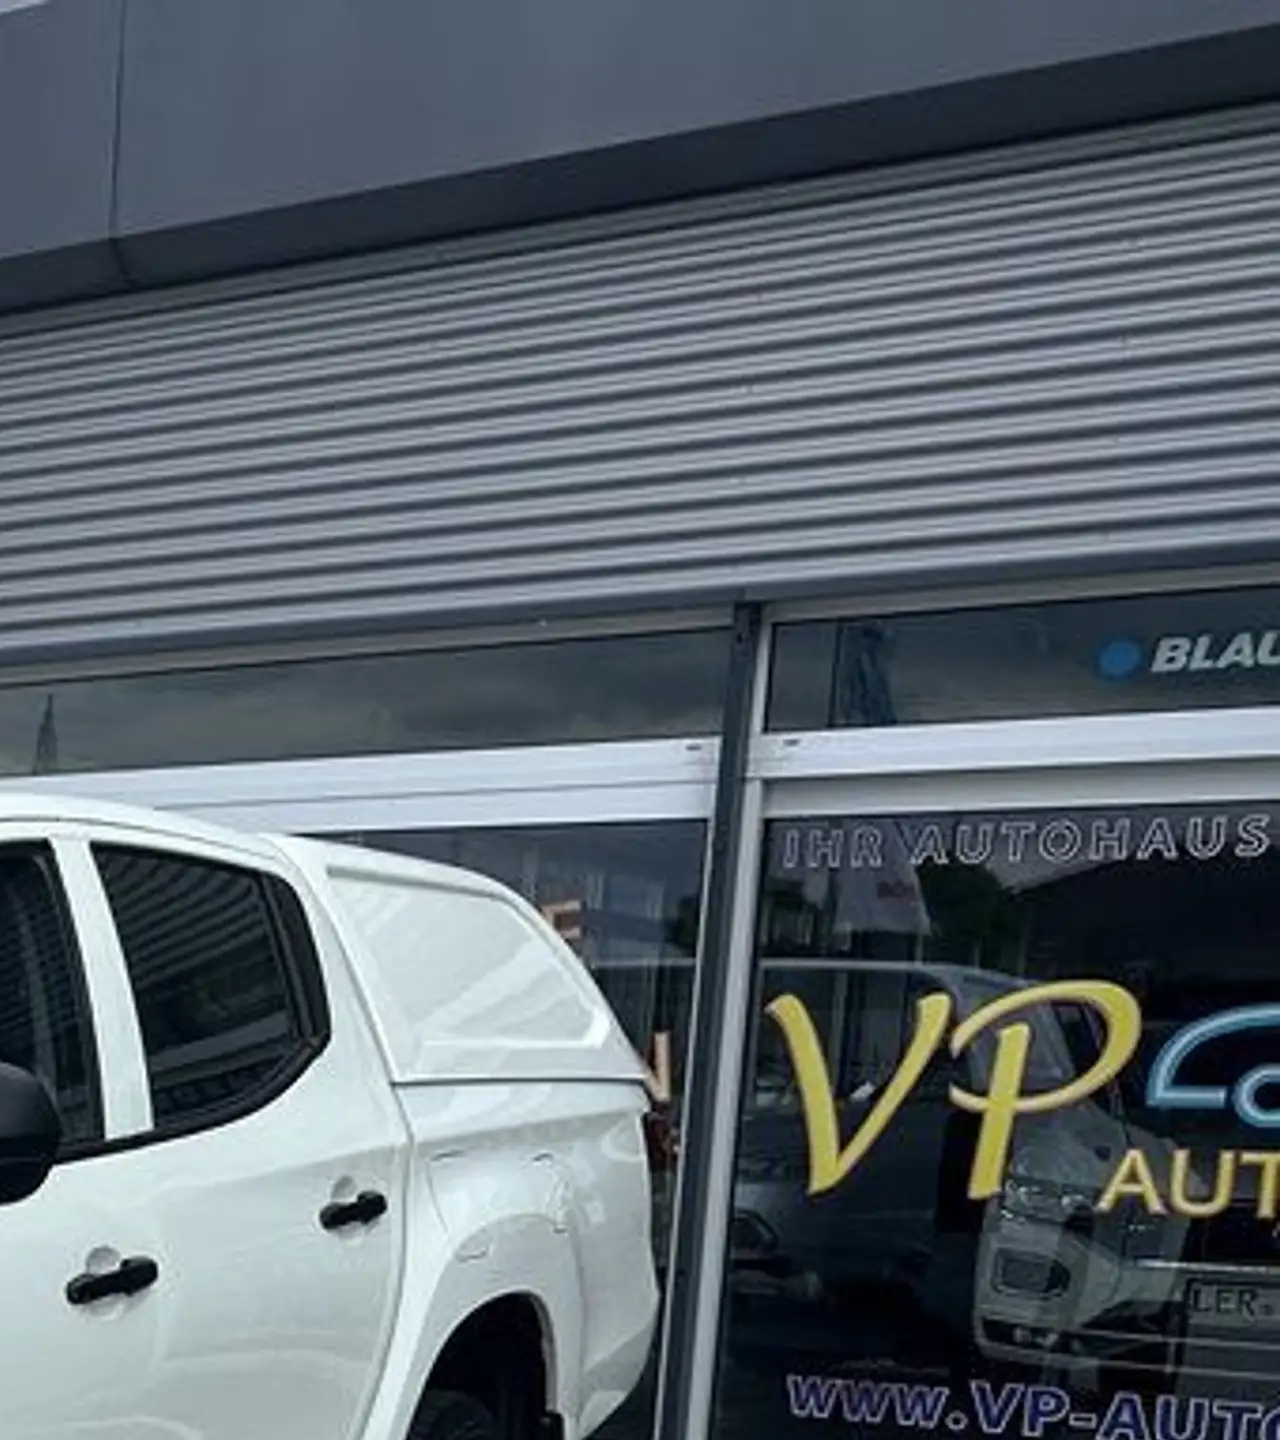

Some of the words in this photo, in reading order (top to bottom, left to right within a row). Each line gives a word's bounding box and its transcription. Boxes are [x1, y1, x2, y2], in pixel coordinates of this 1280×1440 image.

[783, 826, 882, 868] IHR
[910, 813, 1272, 866] AUTOHAUS
[764, 979, 1142, 1200] VP
